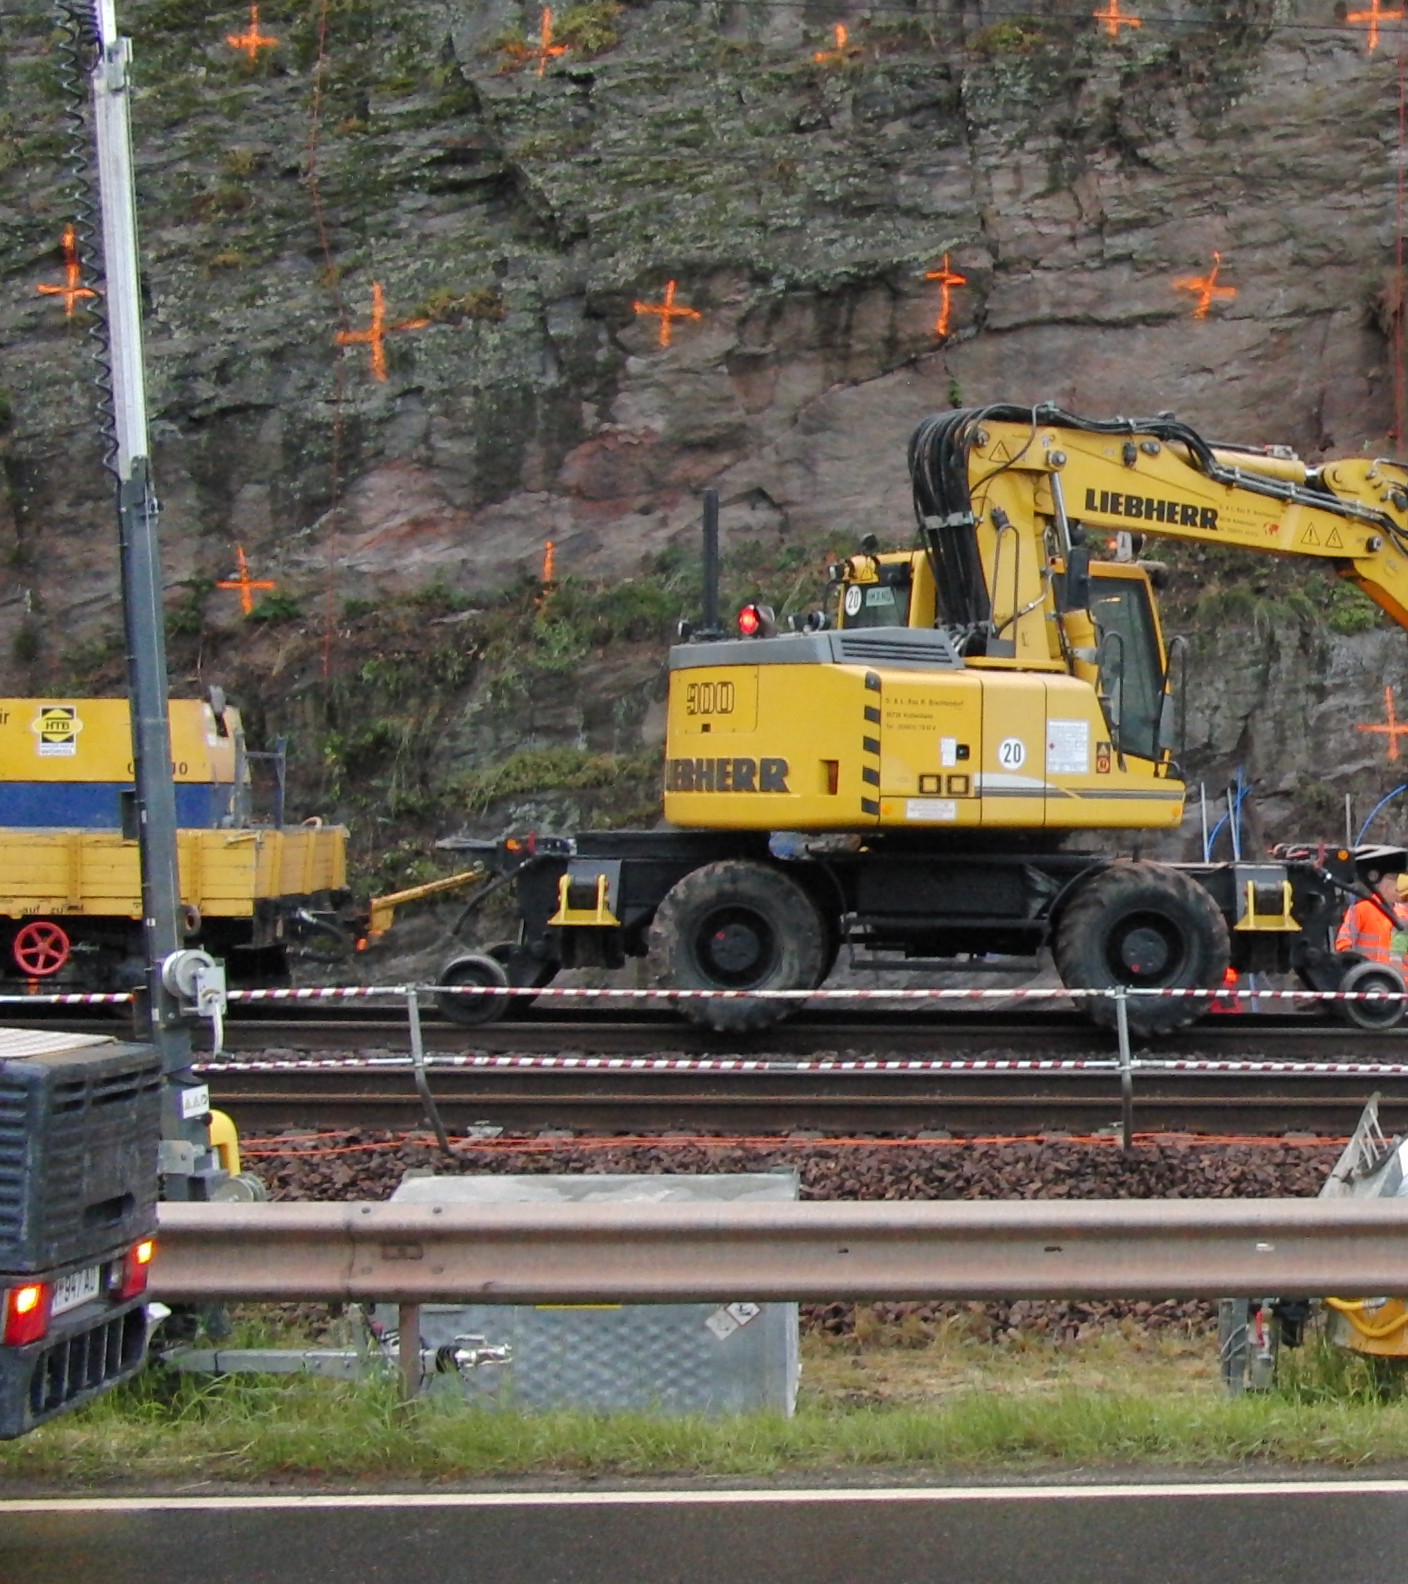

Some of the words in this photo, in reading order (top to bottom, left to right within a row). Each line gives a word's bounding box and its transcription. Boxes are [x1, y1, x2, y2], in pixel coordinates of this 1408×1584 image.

[1085, 488, 1219, 531] LIEBHERR
[848, 590, 859, 609] 20
[686, 681, 735, 715] 900
[45, 721, 70, 730] HTB
[1003, 743, 1022, 764] 20
